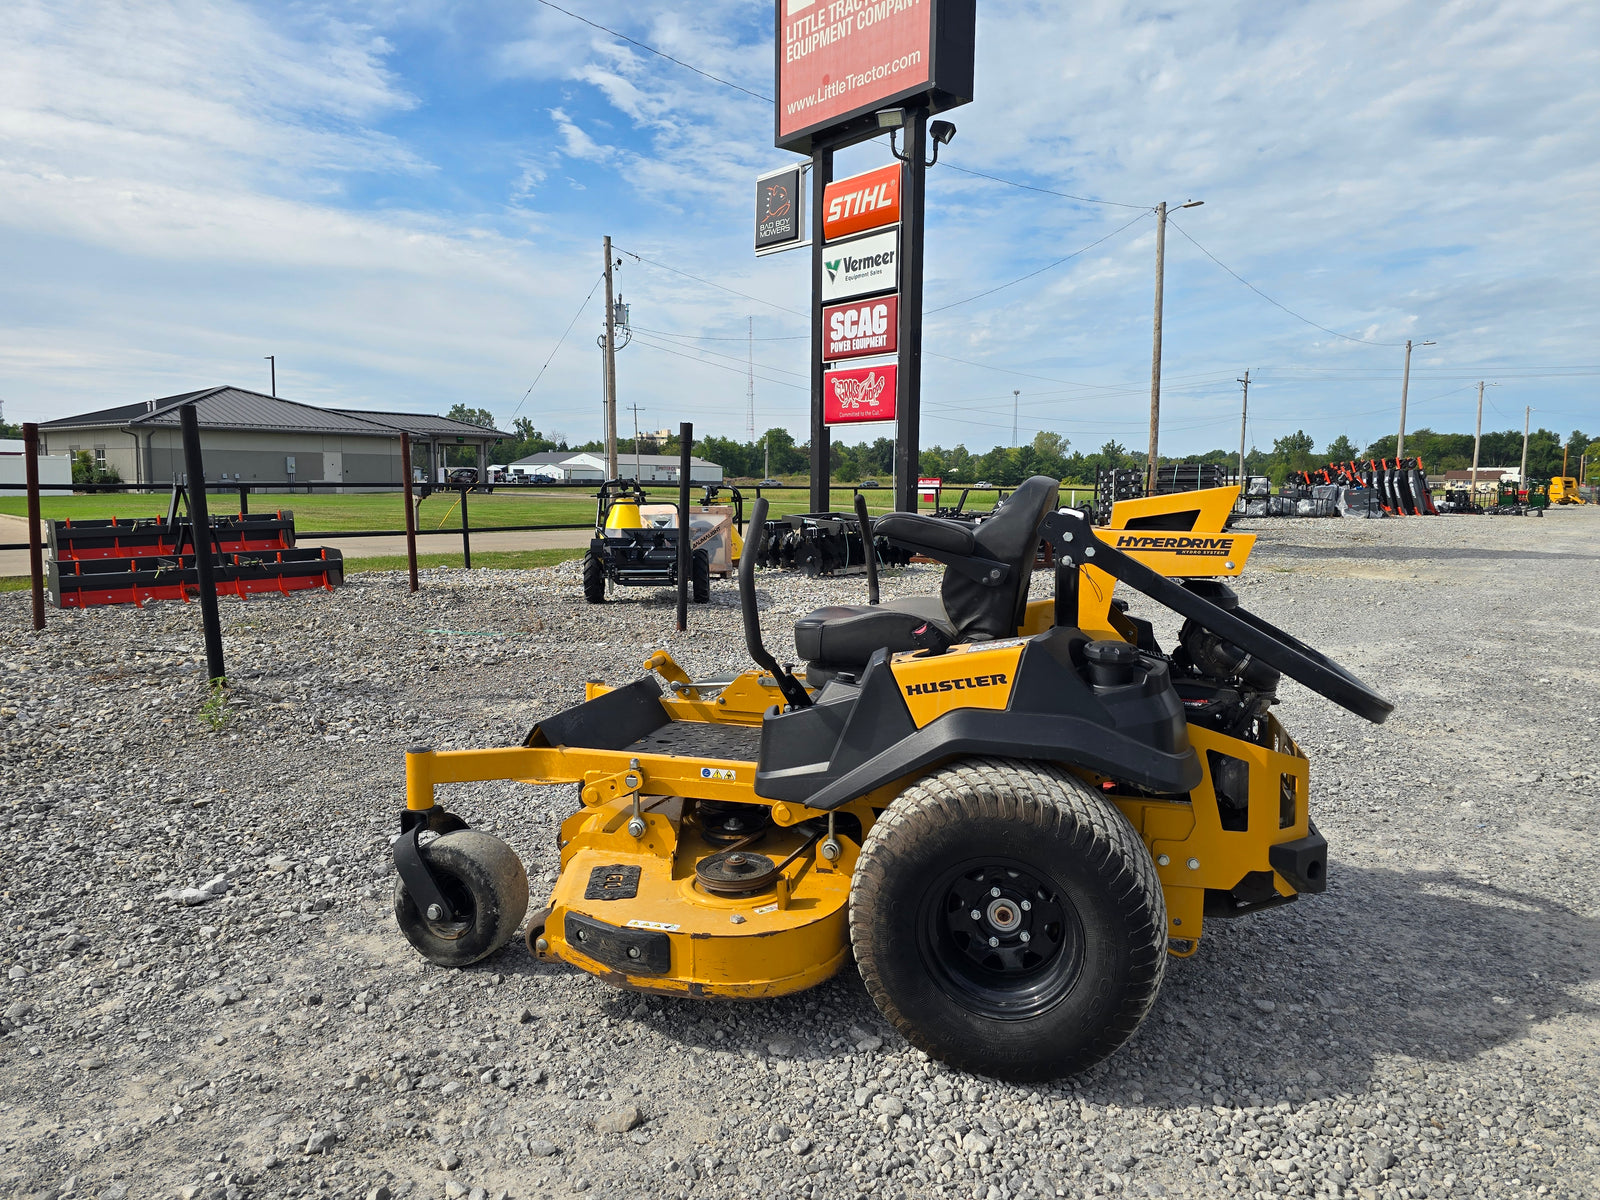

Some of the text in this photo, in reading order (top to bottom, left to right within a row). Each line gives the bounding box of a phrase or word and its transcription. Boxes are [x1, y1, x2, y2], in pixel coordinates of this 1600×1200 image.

[786, 0, 877, 44] LITTLE TRAC
[786, 0, 919, 63] EQUIPMENT COMPA
[787, 50, 921, 115] www.LittleTractor.com
[827, 182, 892, 223] STIHL
[760, 217, 790, 231] BAD BOY
[760, 225, 790, 238] MOWERS
[843, 250, 895, 273] Vermeer
[845, 269, 883, 281] Equipment Sales
[830, 304, 887, 341] SCAG
[830, 335, 887, 353] POWER EQUIPMENT
[1116, 536, 1235, 549] HYPERDRIVE
[905, 673, 1008, 696] HUSTLER
